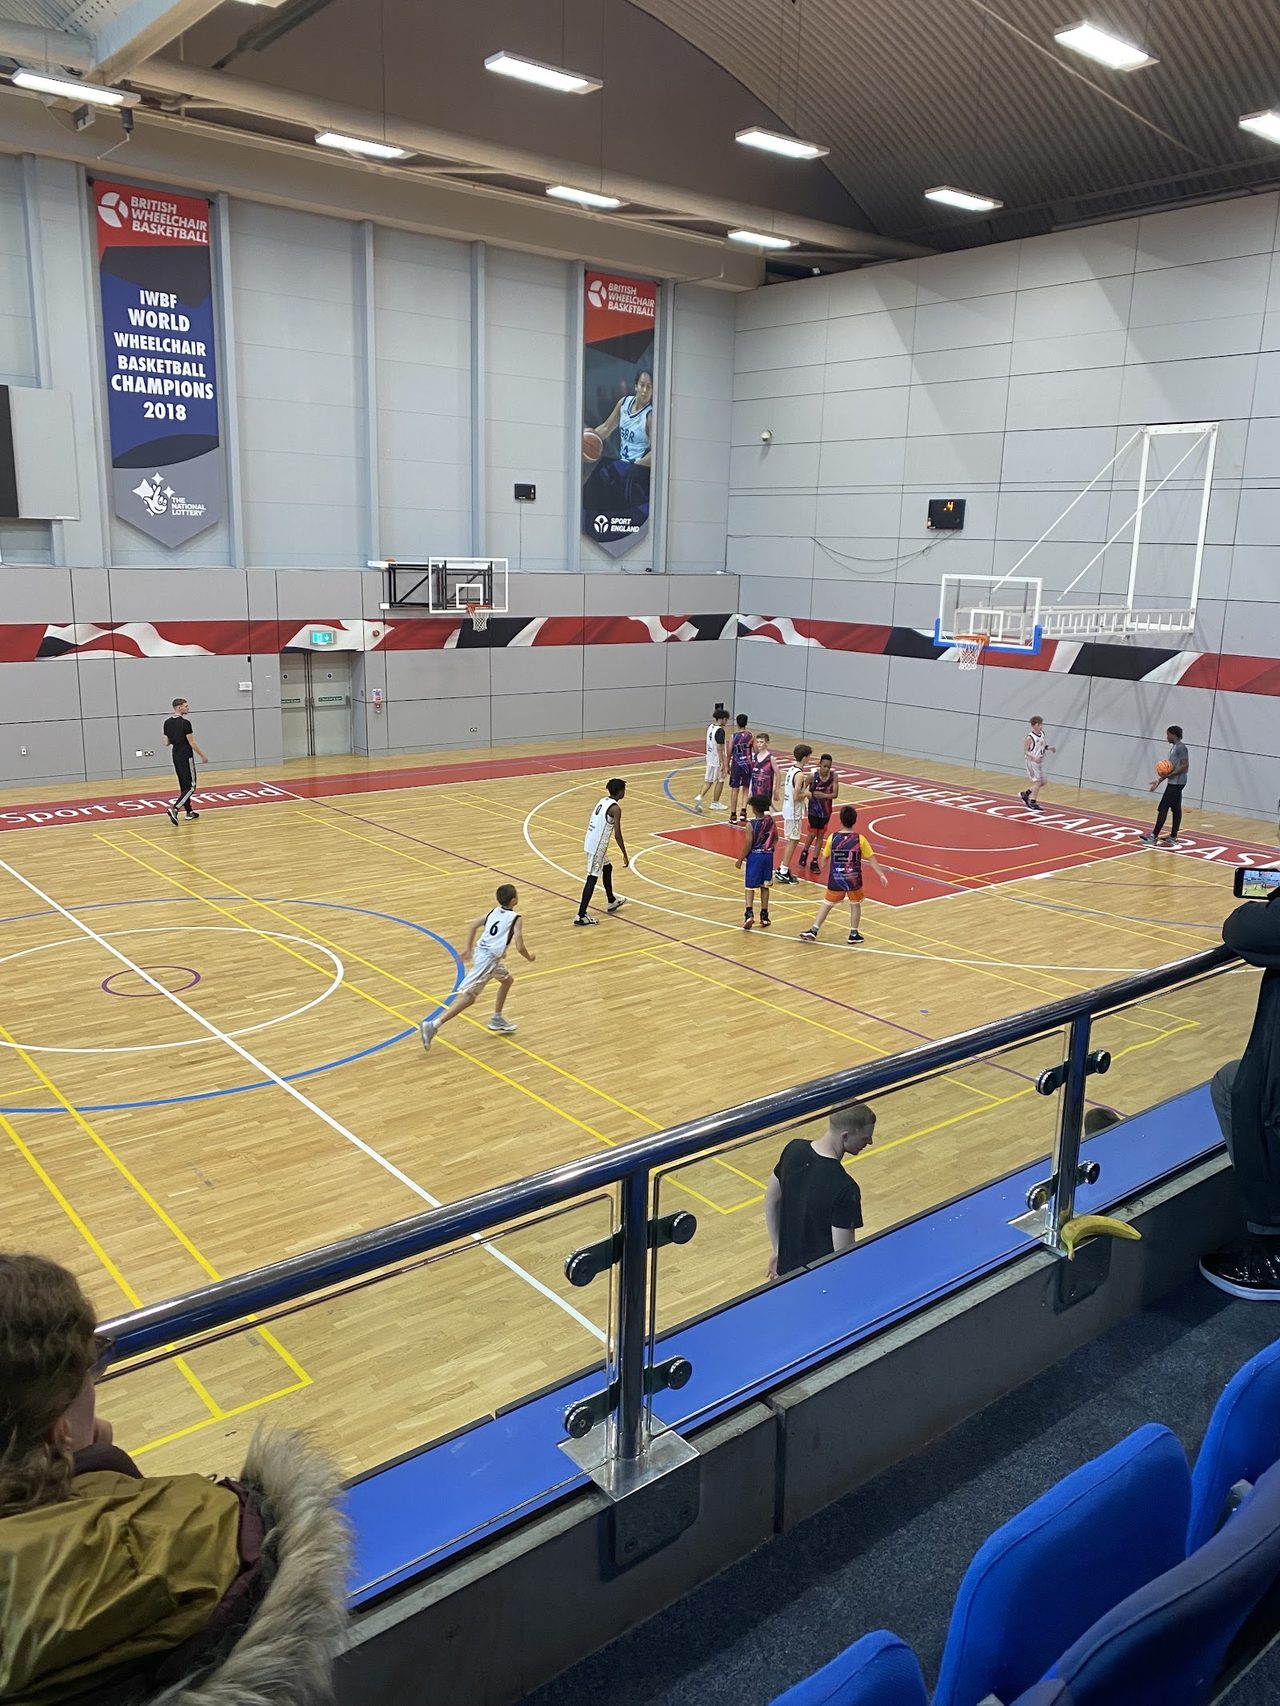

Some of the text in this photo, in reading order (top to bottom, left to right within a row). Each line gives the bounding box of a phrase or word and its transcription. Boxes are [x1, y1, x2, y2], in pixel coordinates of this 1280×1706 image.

[131, 196, 177, 214] BRITISH
[131, 208, 207, 231] WHEELCHAIR
[132, 221, 208, 243] BASKETBALL
[608, 283, 637, 295] BRITISH
[139, 289, 177, 309] IWBF
[608, 292, 655, 308] WHEELCHAIR
[608, 301, 654, 317] BASKETBALL
[127, 308, 190, 332] WORLD
[113, 332, 207, 356] WHEELCHAIR
[117, 354, 206, 378] BASKETBALL
[111, 374, 214, 400] CHAMPIONS
[143, 401, 187, 421] 2018
[171, 503, 207, 511] NATIONAL
[610, 517, 632, 525] SPORT
[610, 525, 640, 533] ENGLAND
[0, 804, 116, 823] Sport
[850, 777, 1143, 841] WHEELCHAIR
[490, 920, 500, 936] 6
